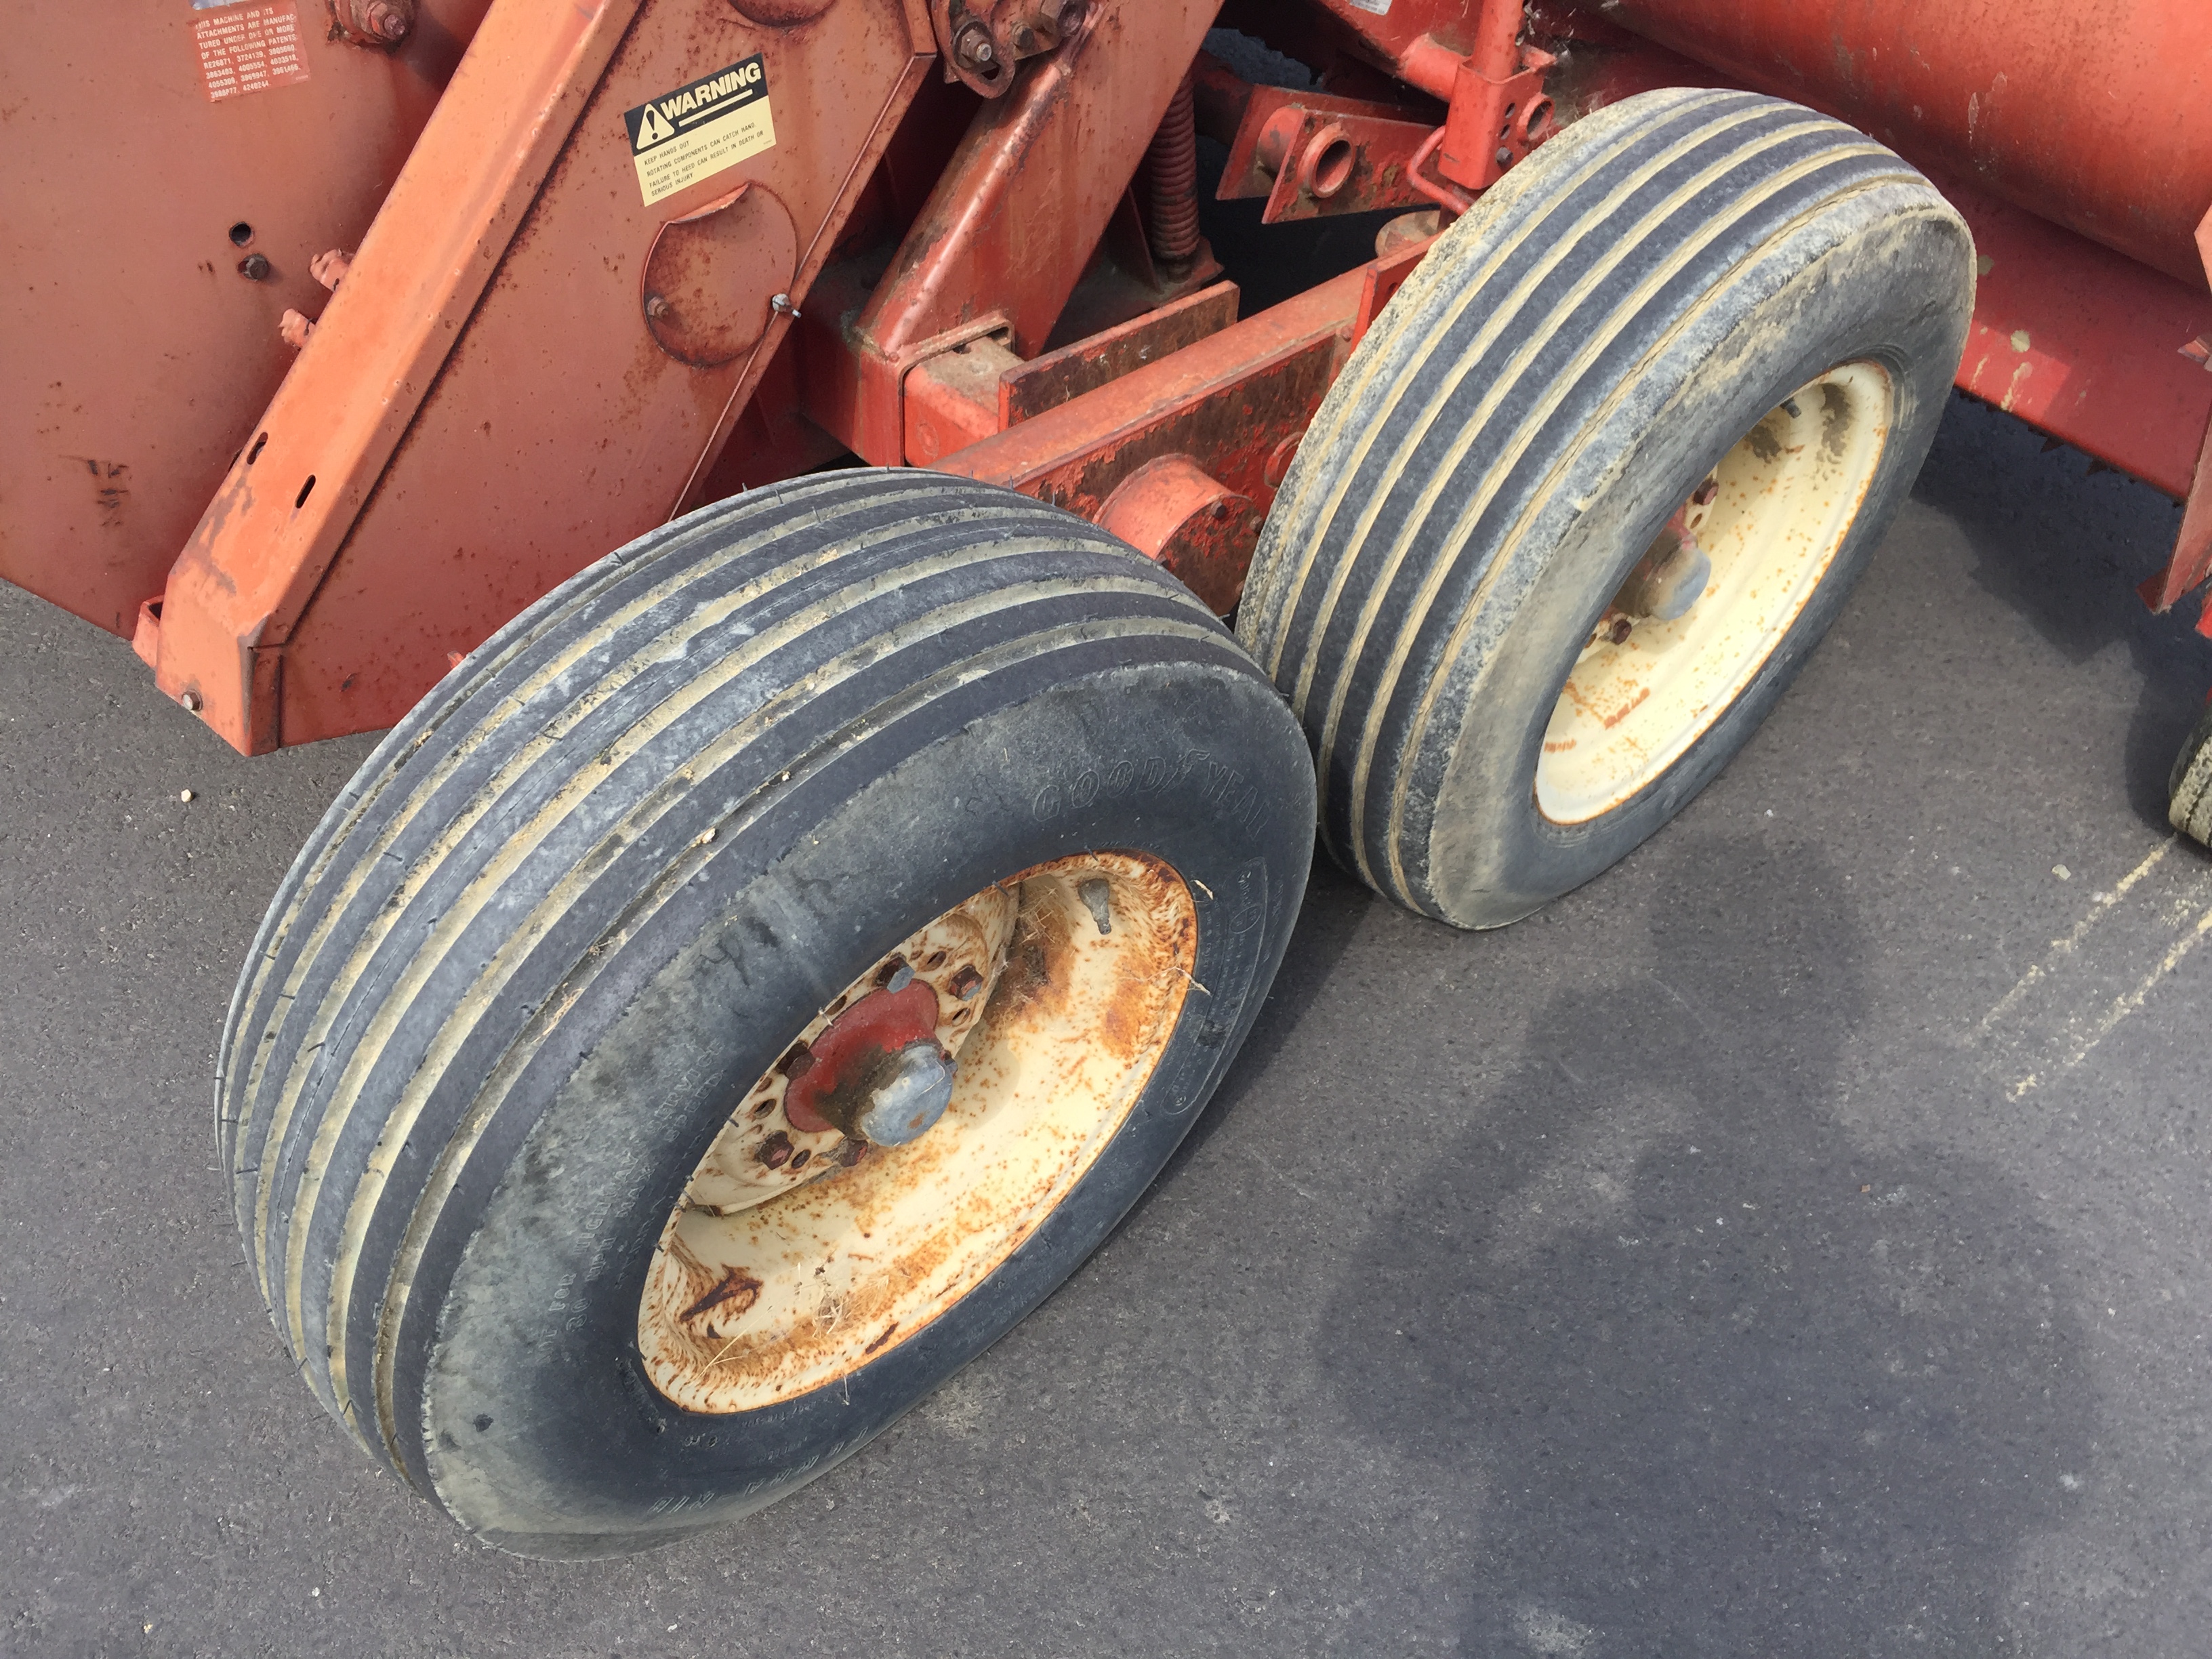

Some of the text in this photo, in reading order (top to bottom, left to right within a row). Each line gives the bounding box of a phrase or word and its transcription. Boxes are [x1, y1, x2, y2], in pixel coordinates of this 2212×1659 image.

[213, 13, 243, 26] MACHINE
[247, 9, 260, 19] AND
[263, 7, 274, 16] ITS
[197, 23, 245, 40] ATTACHMENTS
[247, 21, 260, 30] ARE
[199, 24, 295, 49] TURED UNDER ONE OR MORE
[201, 52, 209, 60] OF
[213, 48, 227, 57] THE
[229, 40, 266, 54] FOLLOWING
[659, 62, 762, 121] WARNING
[644, 140, 689, 165] KEEP HANDS OUT
[647, 161, 672, 177] ROTATING
[674, 144, 708, 164] COMPONENTS
[710, 138, 720, 147] CAN
[722, 130, 739, 141] CATCH
[649, 174, 670, 188] FAILURE
[682, 163, 695, 172] HEED
[697, 157, 708, 165] CAN
[710, 146, 728, 159] RESULT
[739, 135, 754, 146] DEATH
[756, 130, 764, 138] OR
[651, 172, 693, 197] SERIOUS INJURY
[548, 1273, 577, 1311] FOR
[572, 1148, 639, 1256] HIGHWAY
[645, 1038, 725, 1133] SERVICE
[565, 1298, 592, 1332] 30
[584, 1237, 617, 1282] MPH
[616, 1167, 655, 1218] MAX
